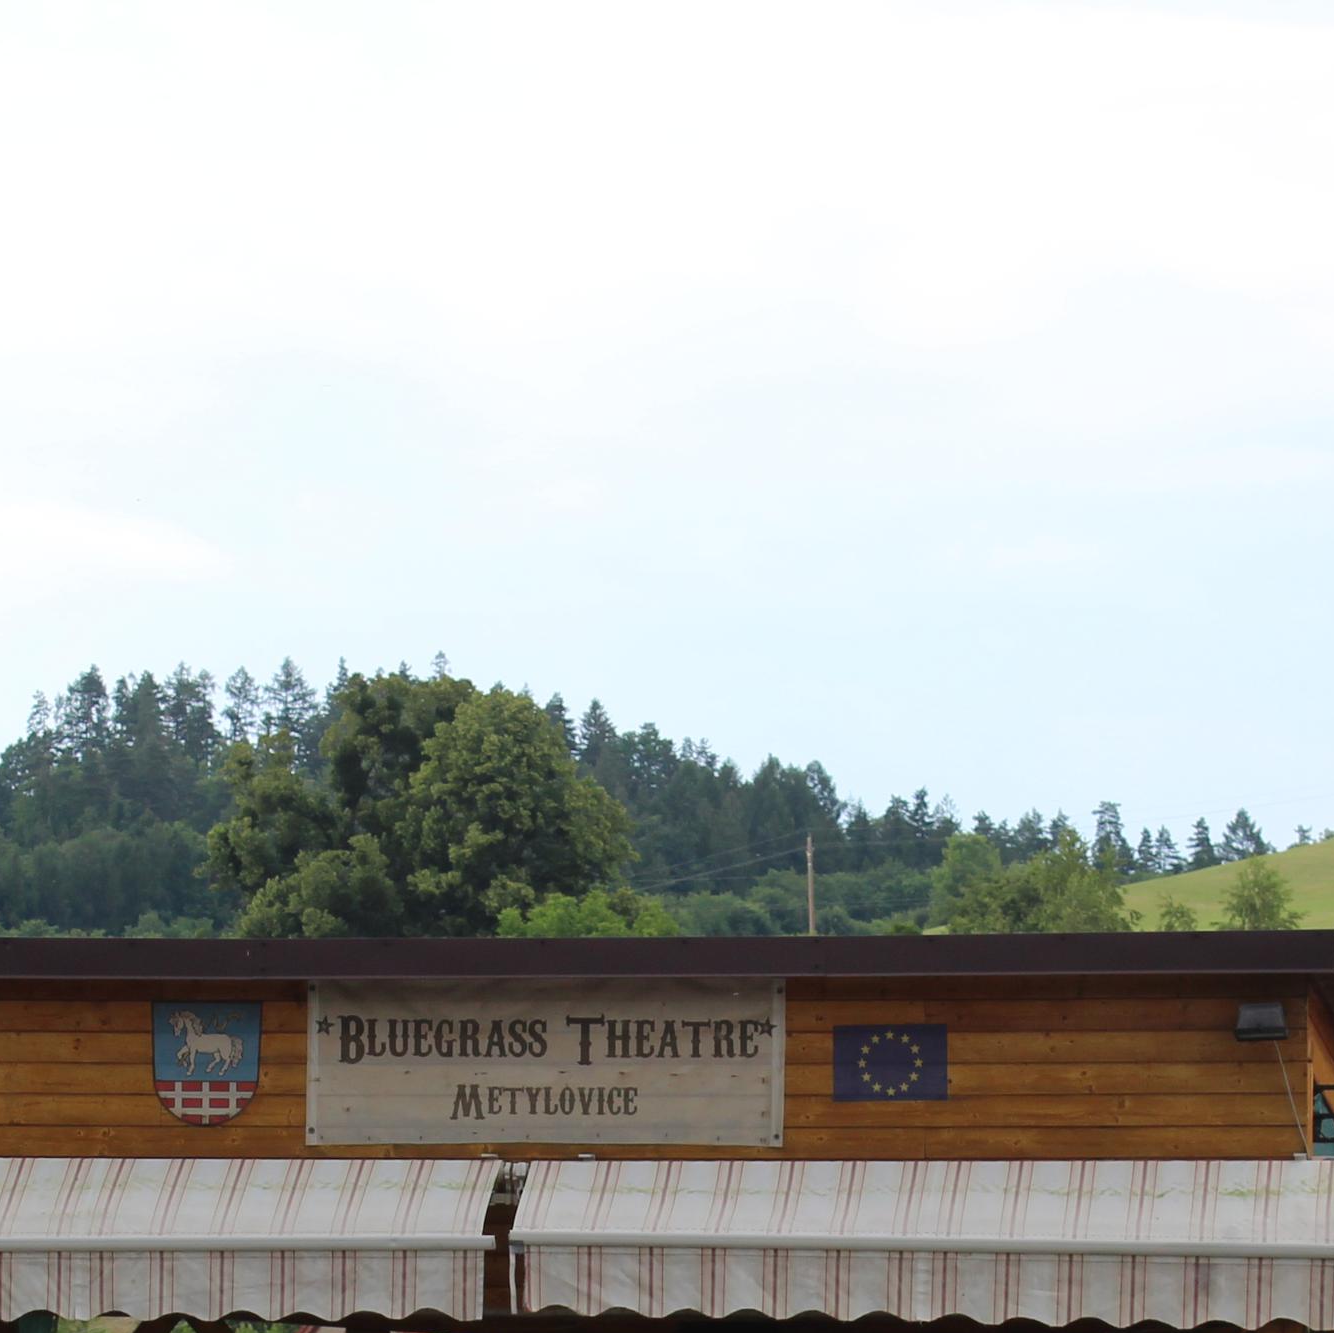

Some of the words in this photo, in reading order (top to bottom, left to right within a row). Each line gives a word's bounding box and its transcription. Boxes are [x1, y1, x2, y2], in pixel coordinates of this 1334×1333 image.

[337, 1014, 548, 1065] BLUEGRASS
[566, 1013, 759, 1066] THEATRE
[450, 1083, 638, 1120] METYLOVICE
